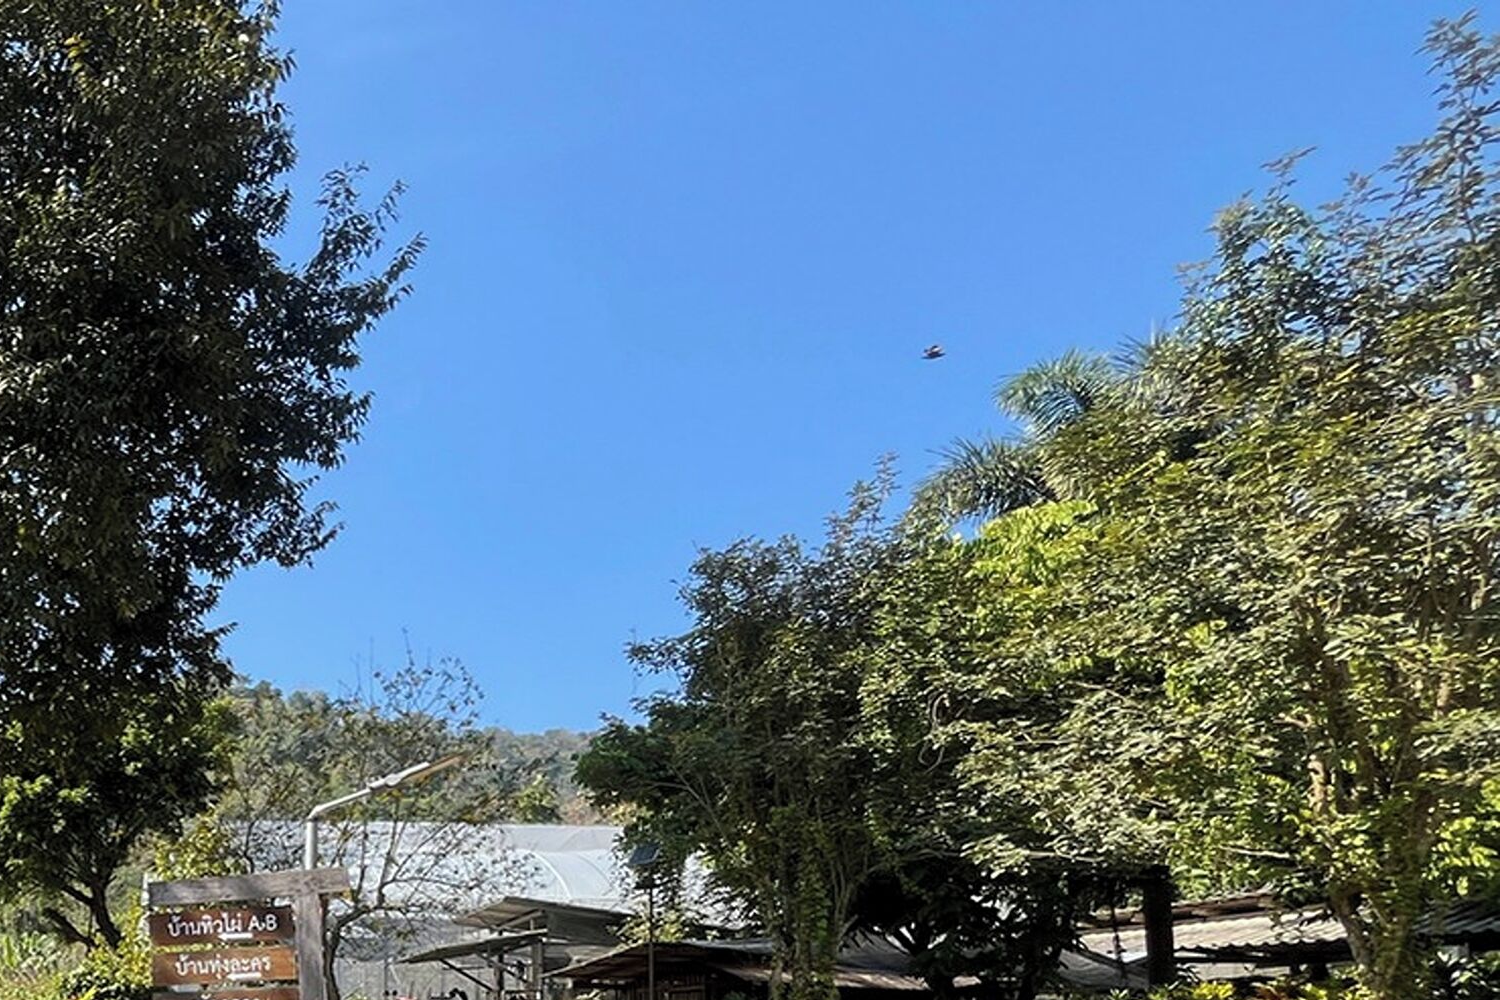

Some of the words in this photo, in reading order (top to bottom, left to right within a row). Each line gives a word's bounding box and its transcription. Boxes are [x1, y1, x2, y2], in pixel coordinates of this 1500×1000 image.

[167, 912, 242, 937] บ้านทิวไผ่
[175, 954, 271, 980] บ้านทุ่งละคร
